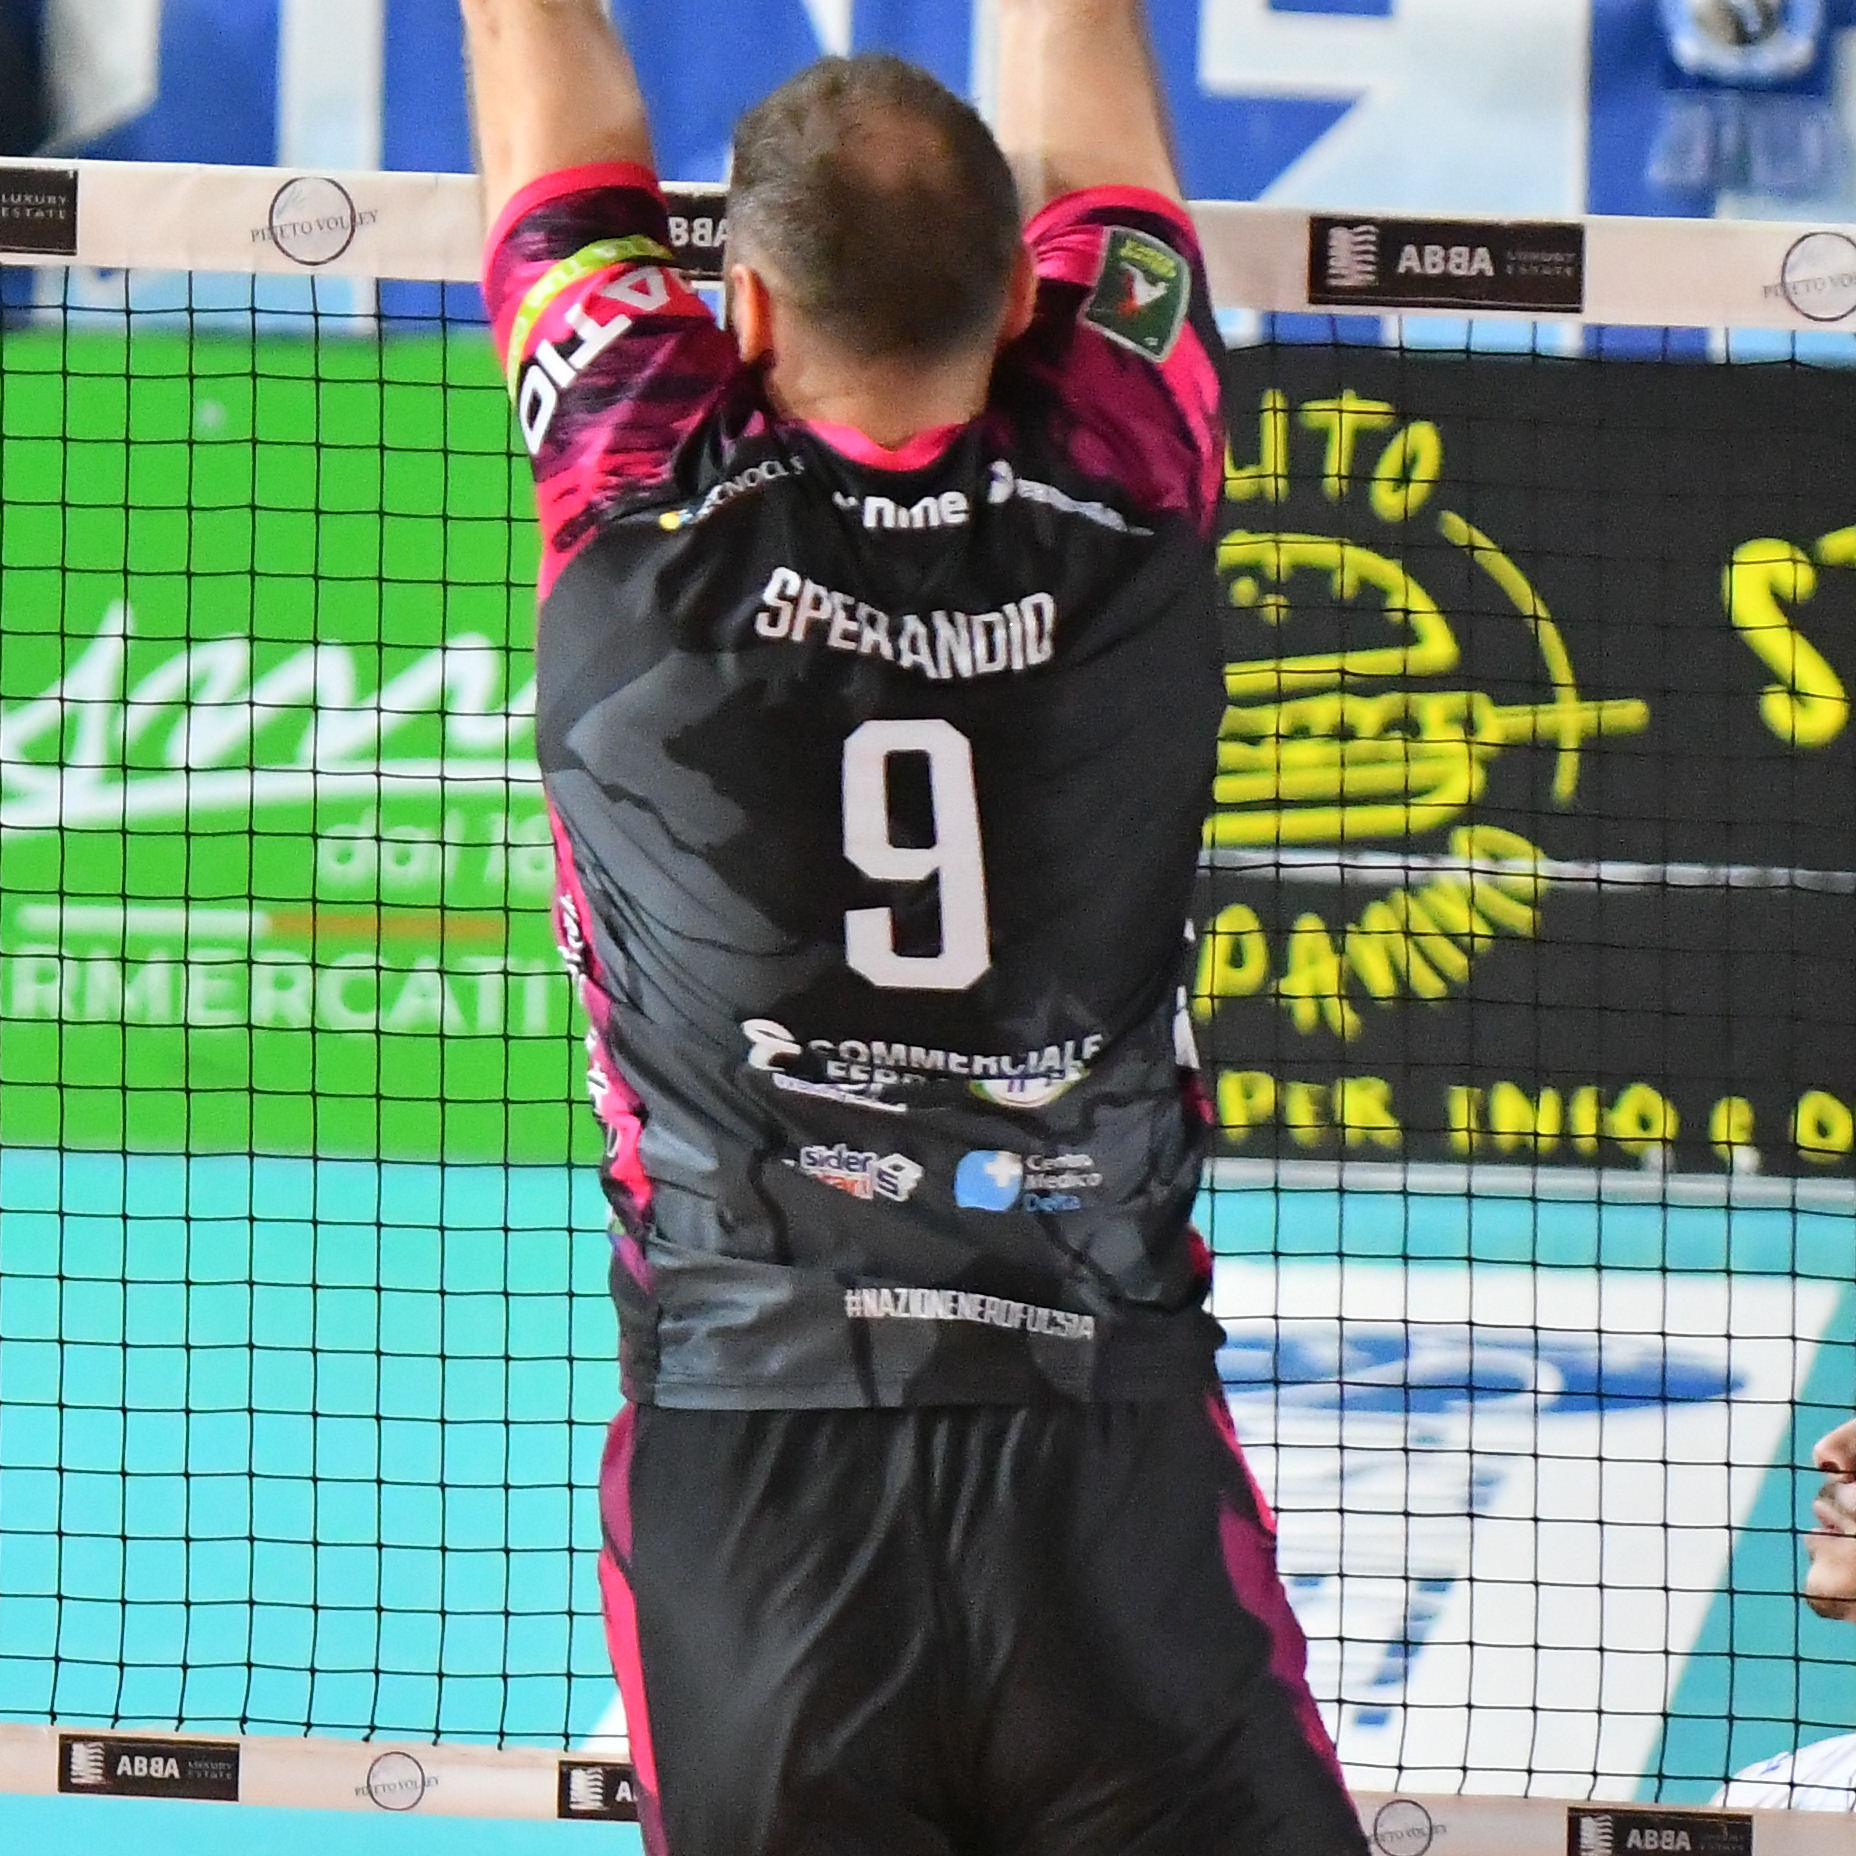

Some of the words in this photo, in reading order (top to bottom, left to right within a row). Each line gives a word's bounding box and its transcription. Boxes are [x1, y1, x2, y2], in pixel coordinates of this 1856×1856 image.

[668, 216, 729, 248] BBA
[1397, 244, 1494, 279] ABBA
[755, 566, 1057, 680] SPERANDIO
[841, 718, 992, 991] 9
[1216, 1069, 1403, 1150] PER
[116, 1755, 180, 1779] ABBA
[1626, 1829, 1692, 1852] ABBA
